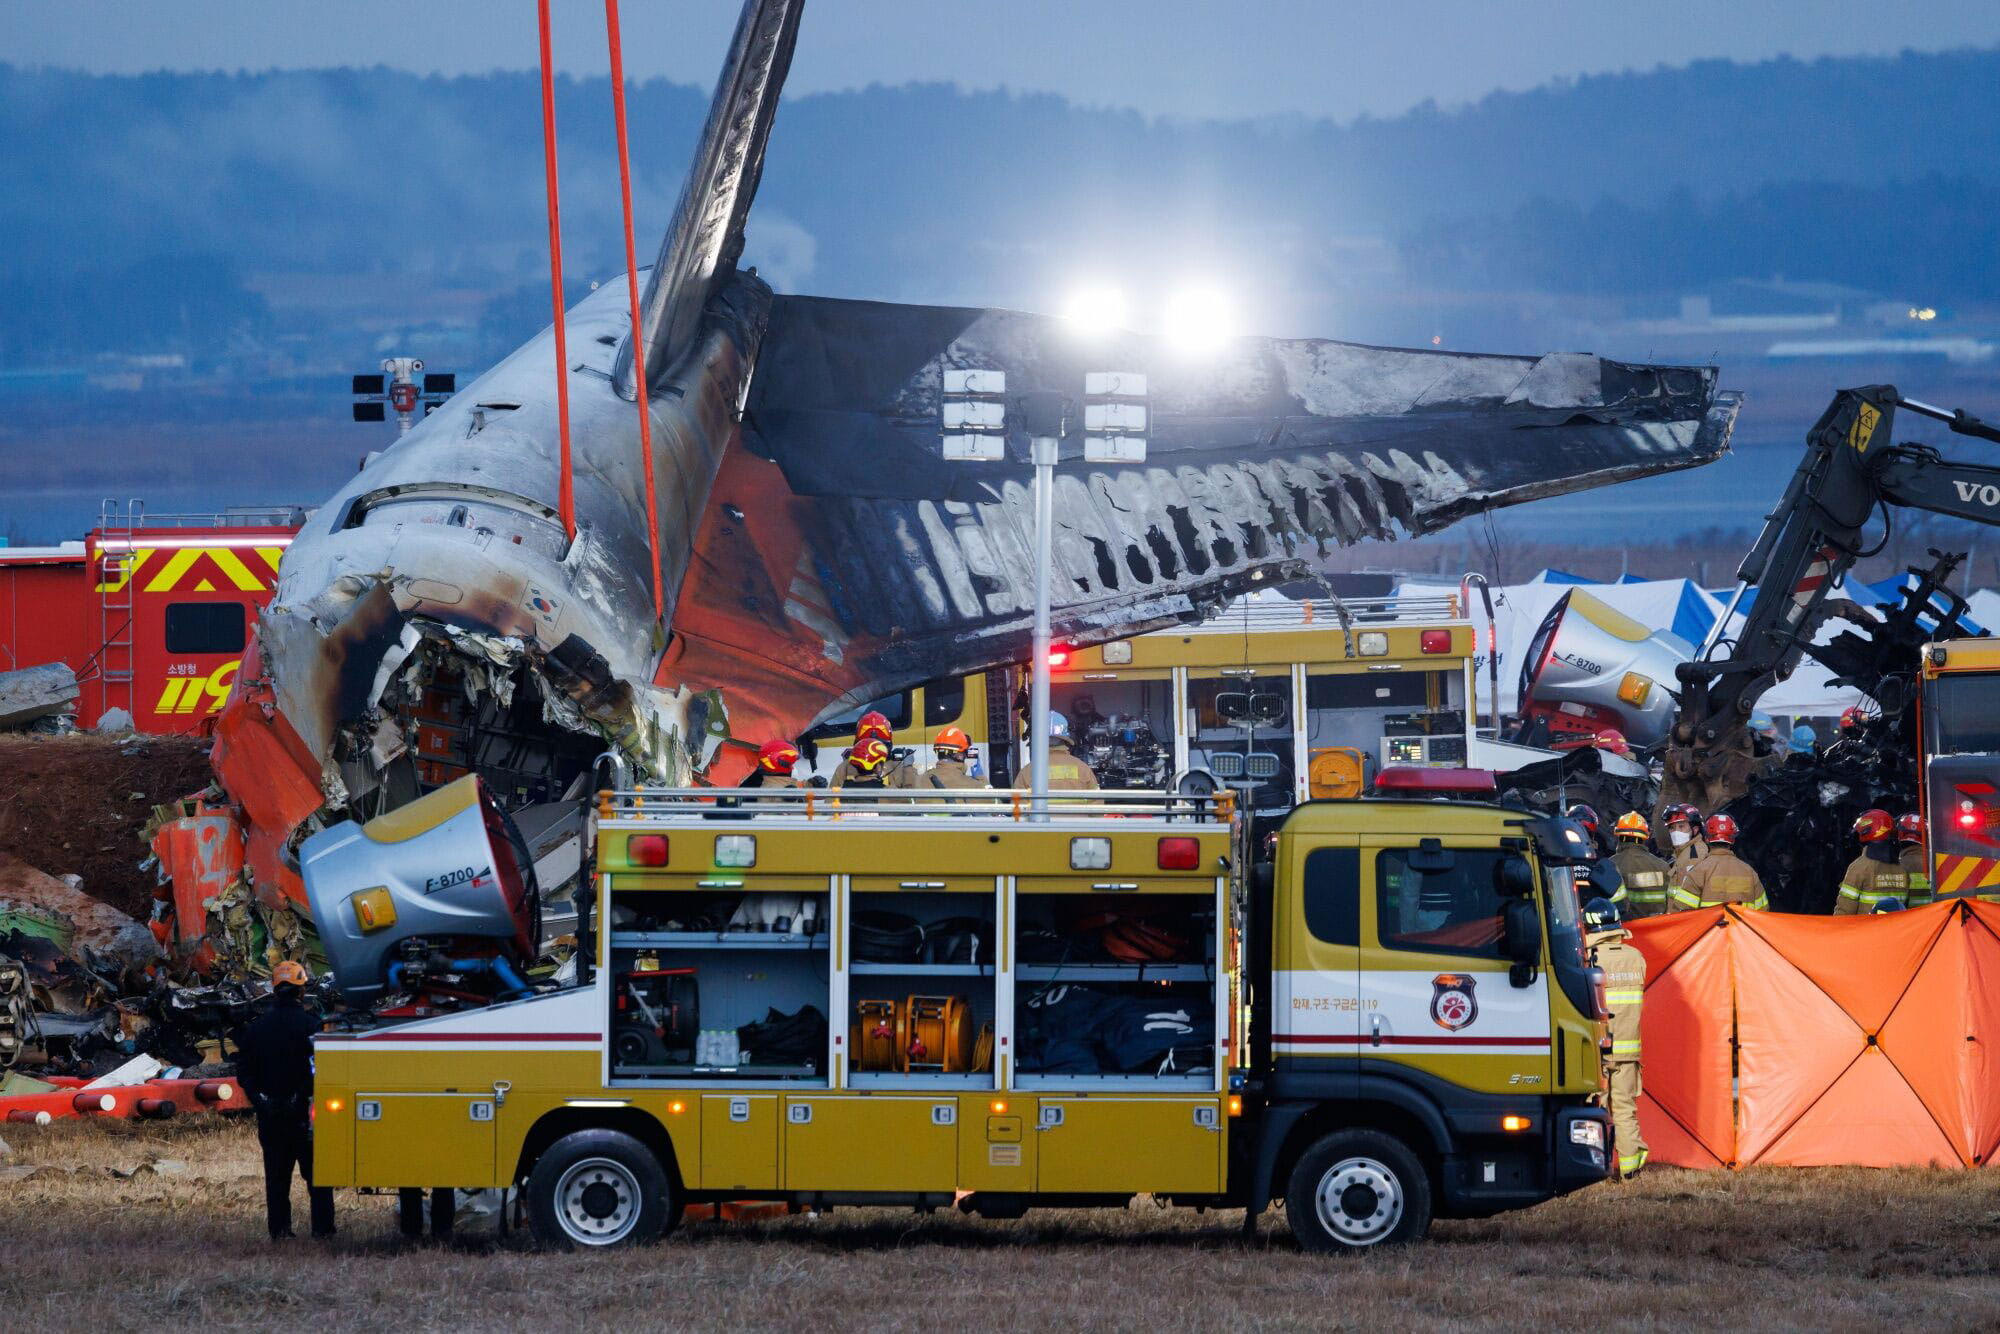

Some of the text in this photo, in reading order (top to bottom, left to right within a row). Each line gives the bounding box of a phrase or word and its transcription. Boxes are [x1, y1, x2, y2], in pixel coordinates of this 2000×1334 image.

[167, 663, 197, 675] 소방청
[1564, 653, 1602, 674] F-8700
[425, 866, 475, 892] F-8700
[1361, 999, 1378, 1010] 119
